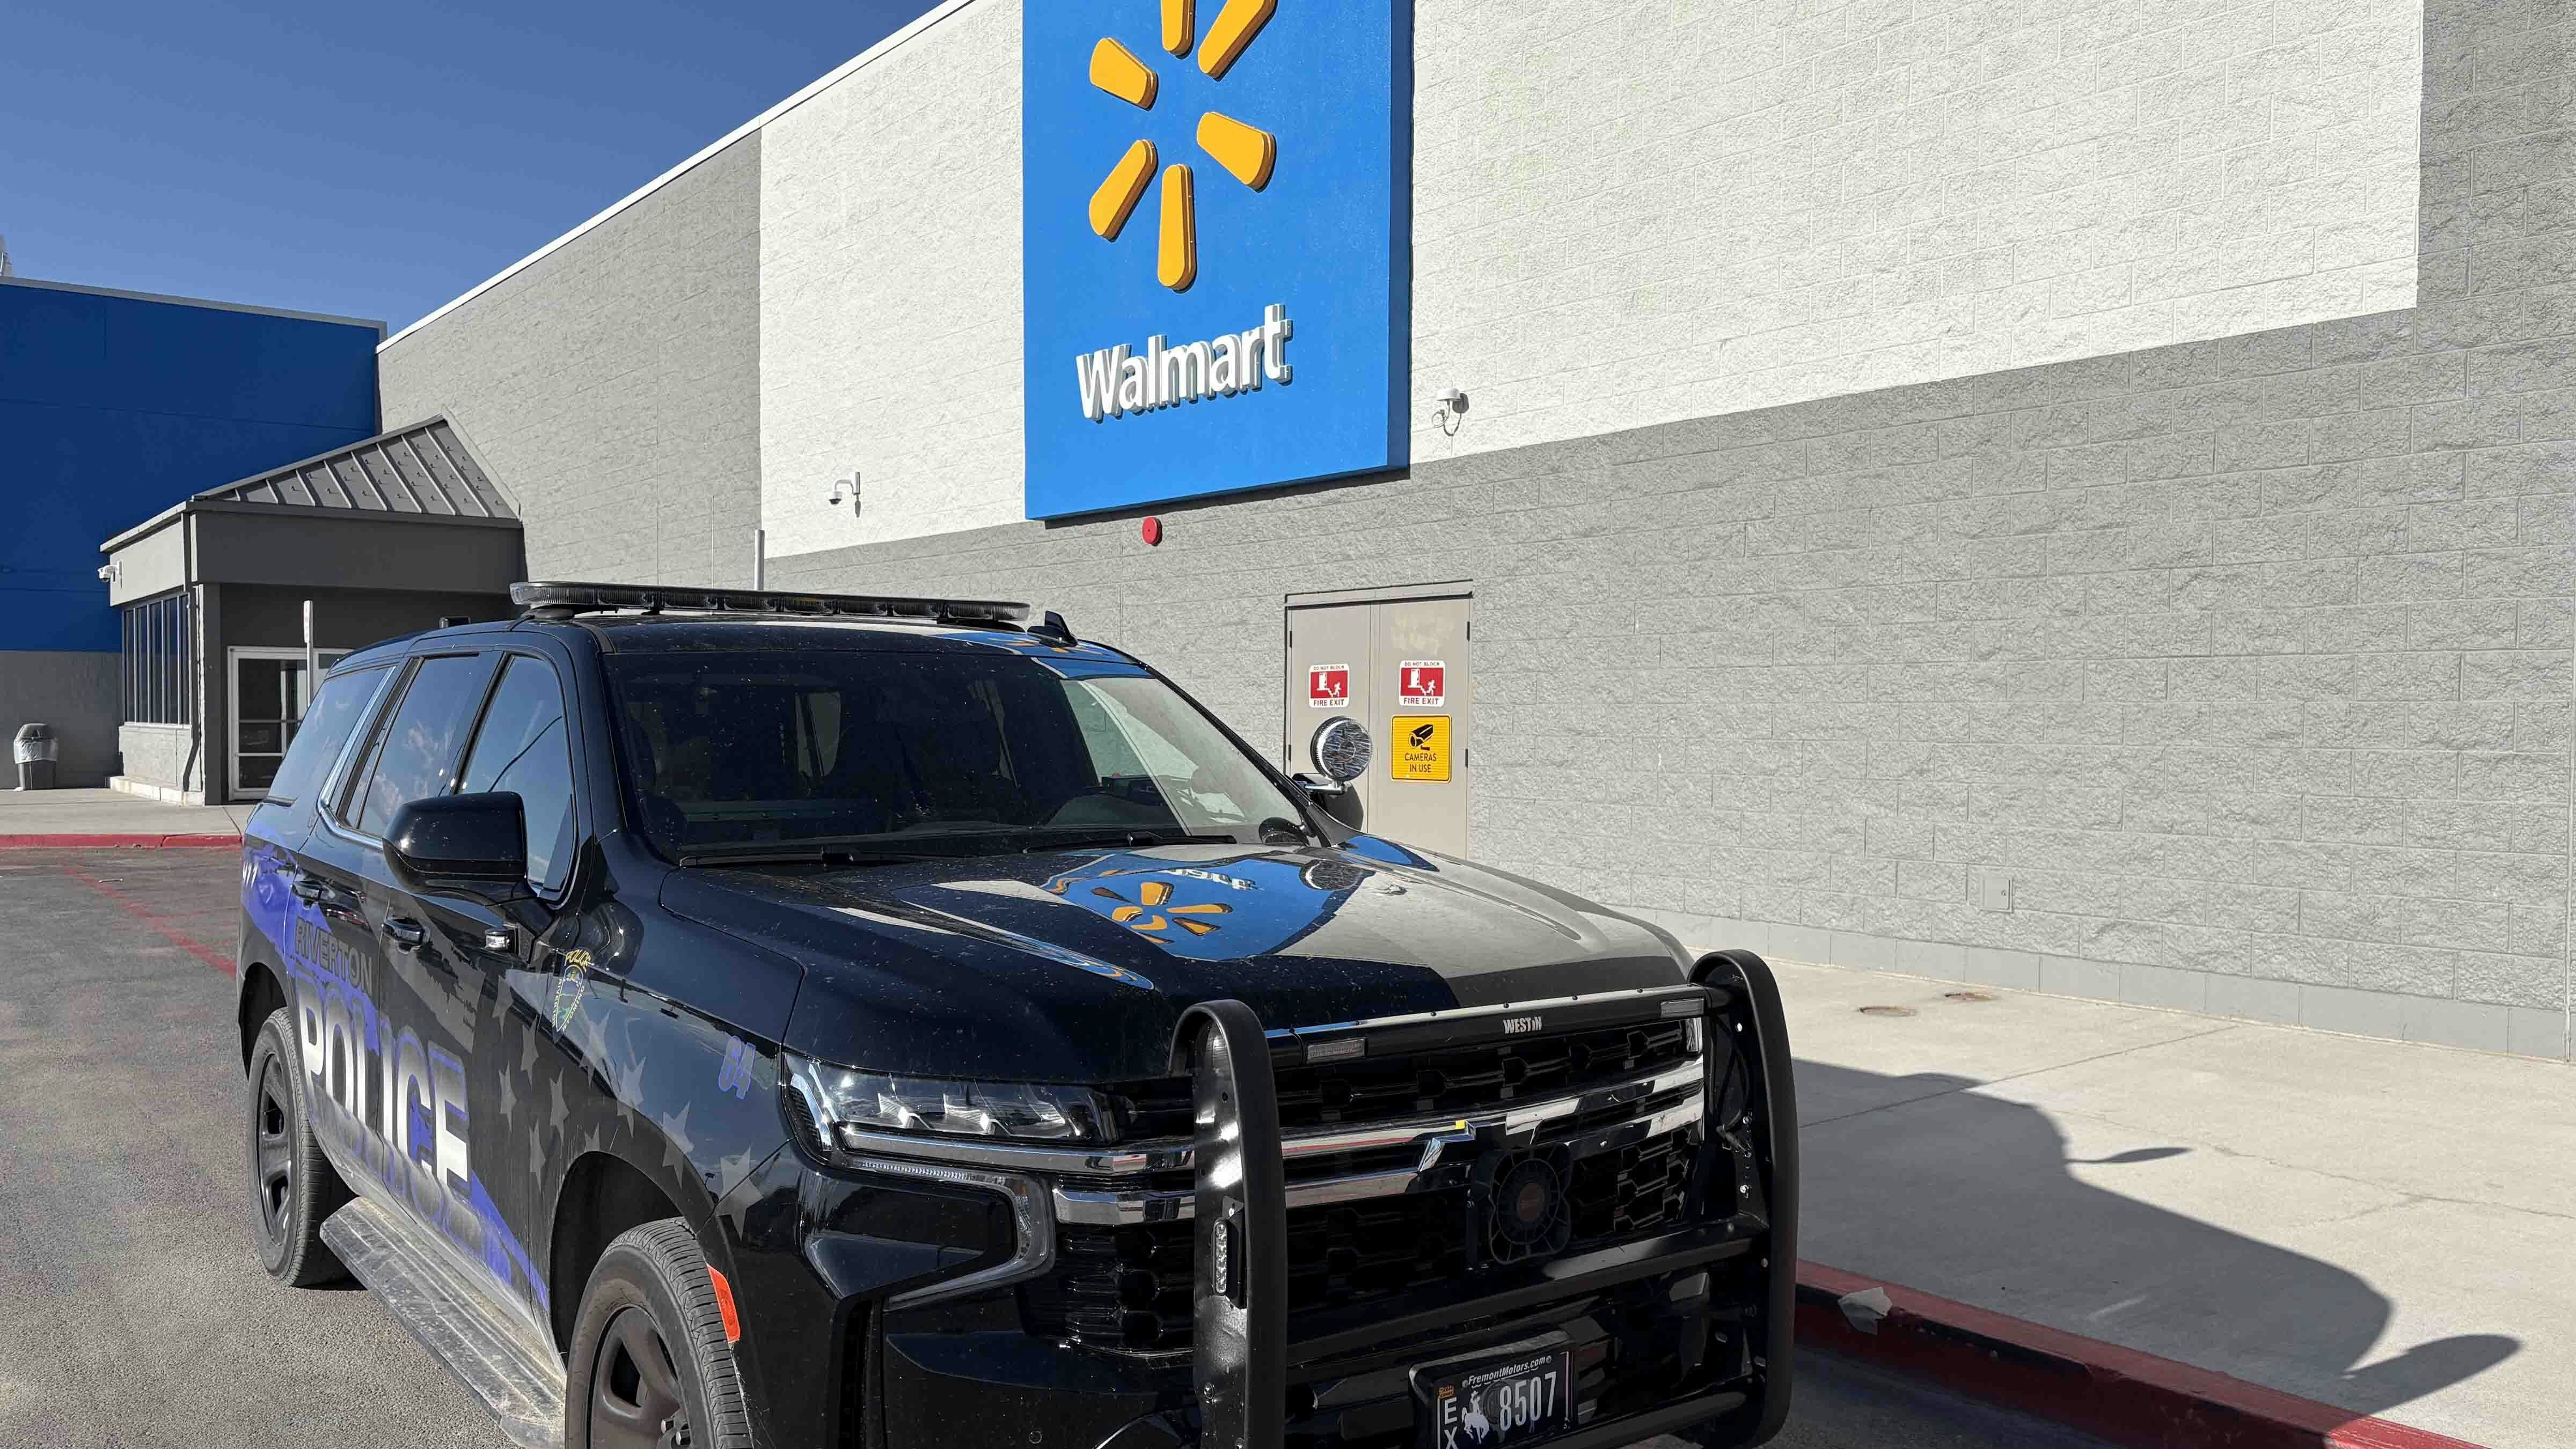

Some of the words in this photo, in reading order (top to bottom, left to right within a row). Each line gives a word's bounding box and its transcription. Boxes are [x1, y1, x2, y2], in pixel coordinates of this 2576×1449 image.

[1075, 303, 1293, 421] Walmart
[1404, 752, 1437, 762] CAMERAS
[1409, 764, 1417, 772] IN
[1418, 764, 1432, 773] USE
[296, 916, 373, 997] RIVERTON
[296, 975, 475, 1210] POLICE
[1467, 1356, 1546, 1386] FremontMotors.com
[1499, 1371, 1557, 1432] 8507
